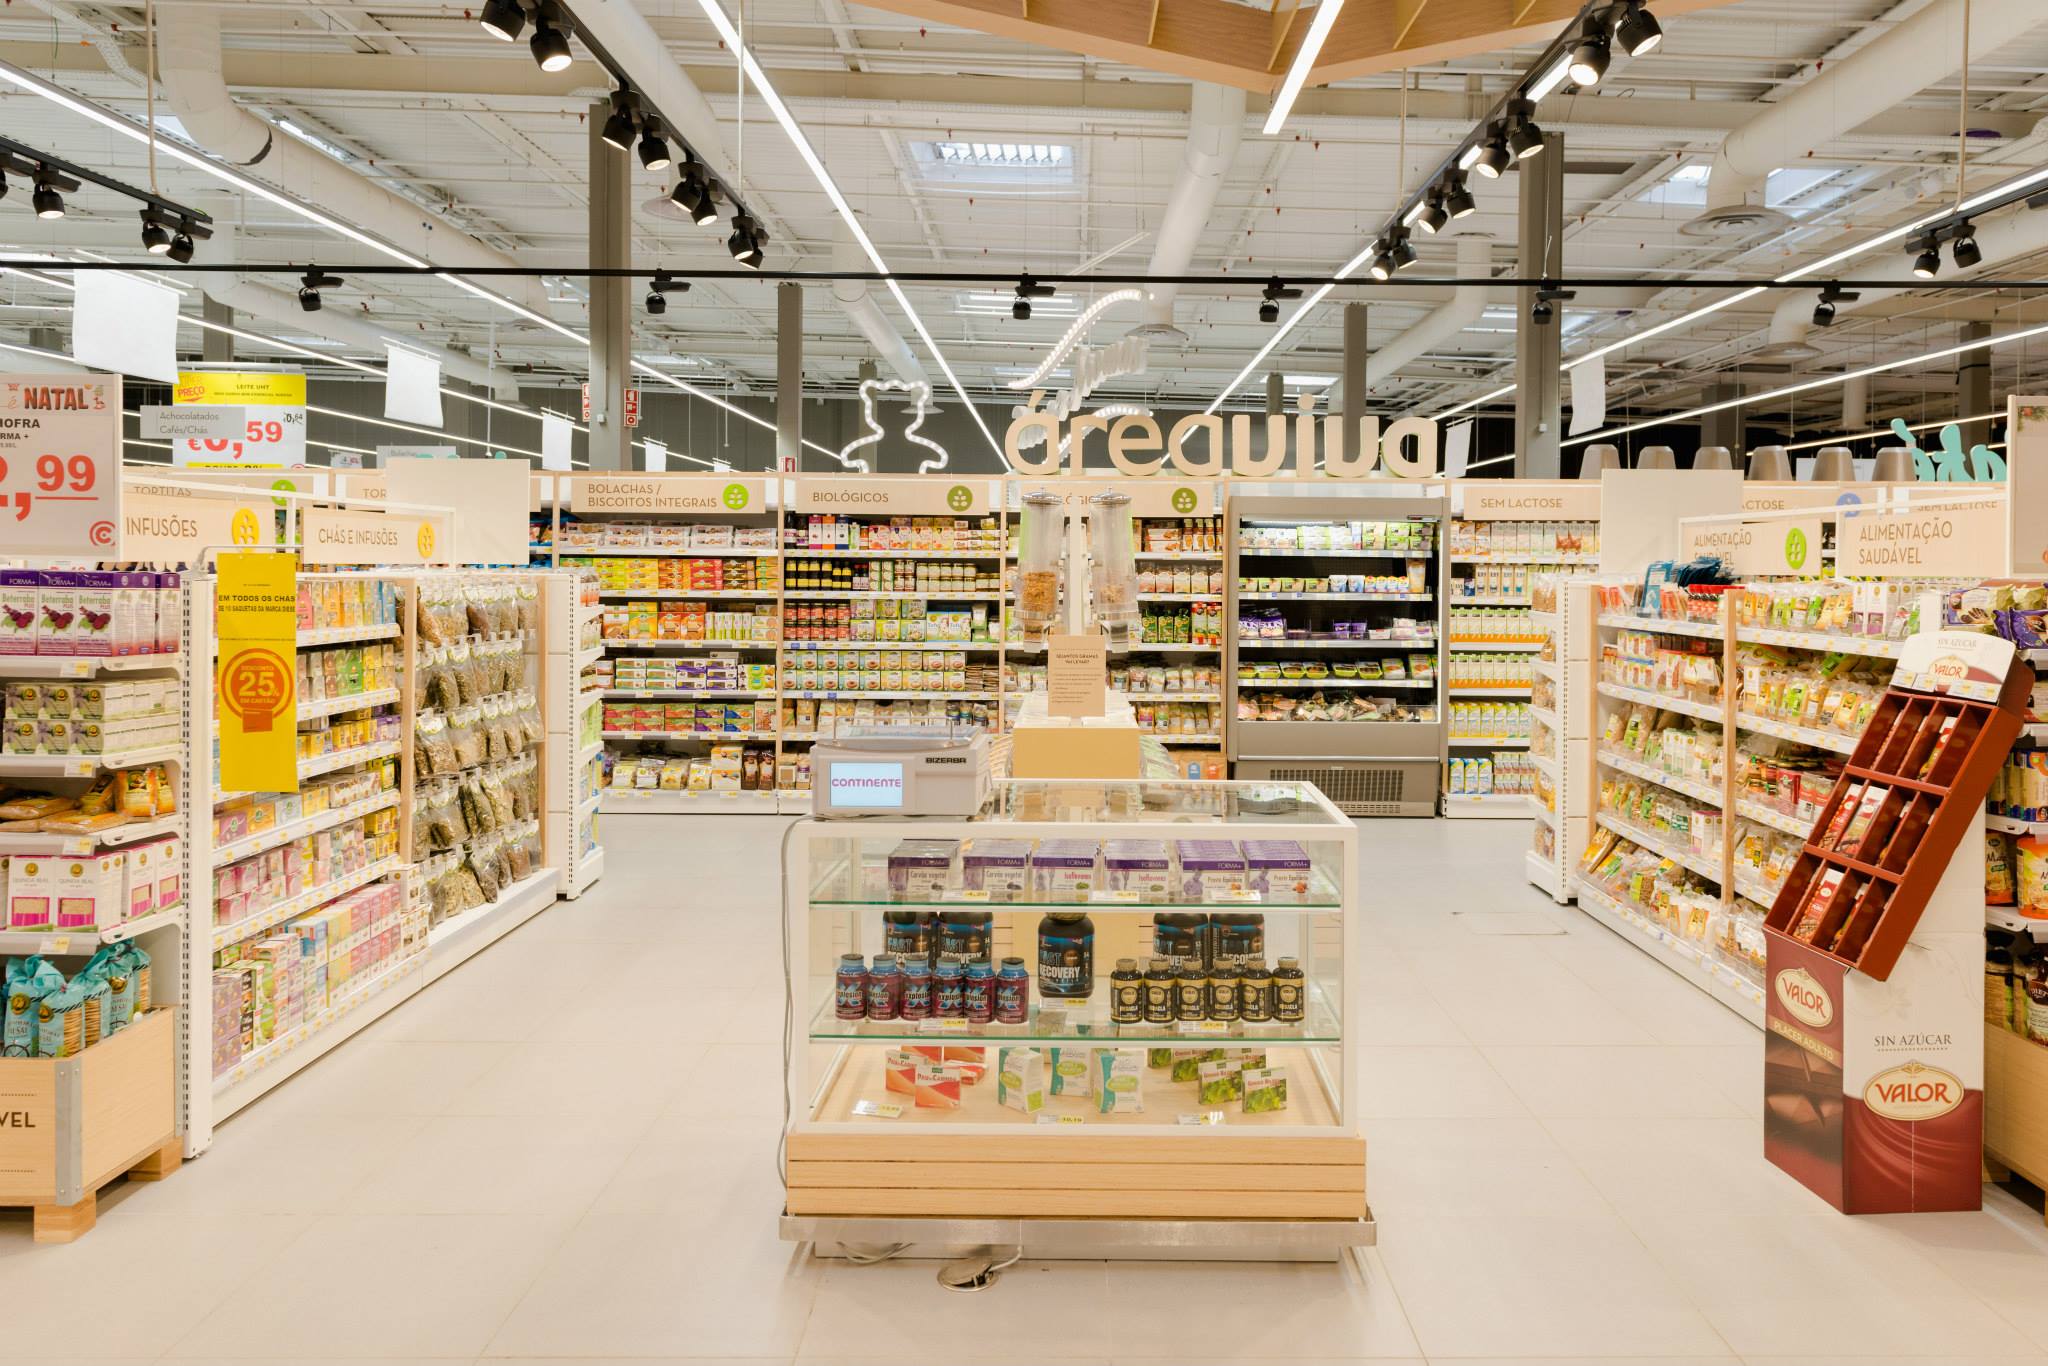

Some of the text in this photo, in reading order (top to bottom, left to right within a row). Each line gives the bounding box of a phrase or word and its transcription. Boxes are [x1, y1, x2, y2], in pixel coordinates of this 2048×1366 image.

[24, 386, 89, 411] NATAL
[160, 411, 220, 421] Achocolatados
[160, 425, 209, 435] Cafés/Chás
[588, 483, 654, 495] BOLACHAS
[812, 489, 889, 503] BIOLÓGICOS
[588, 496, 717, 508] BISCOITOS INTEGRAIS
[1480, 498, 1563, 508] SEM LACTOSE
[126, 514, 198, 538] INFUSÕES
[1860, 517, 1953, 544] ALIMENTAÇÃO
[319, 527, 398, 546] CHÁS E INFUSÕES
[1695, 528, 1752, 549] ALIMENTAÇÃO
[1859, 543, 1922, 565] SAUDÁVEL
[1933, 663, 1963, 678] VALOR
[1040, 963, 1080, 979] RECOVERY
[1782, 976, 1826, 1018] VALOR
[1874, 1031, 1953, 1047] SIN AZÚCAR
[1874, 1083, 1953, 1104] VALOR
